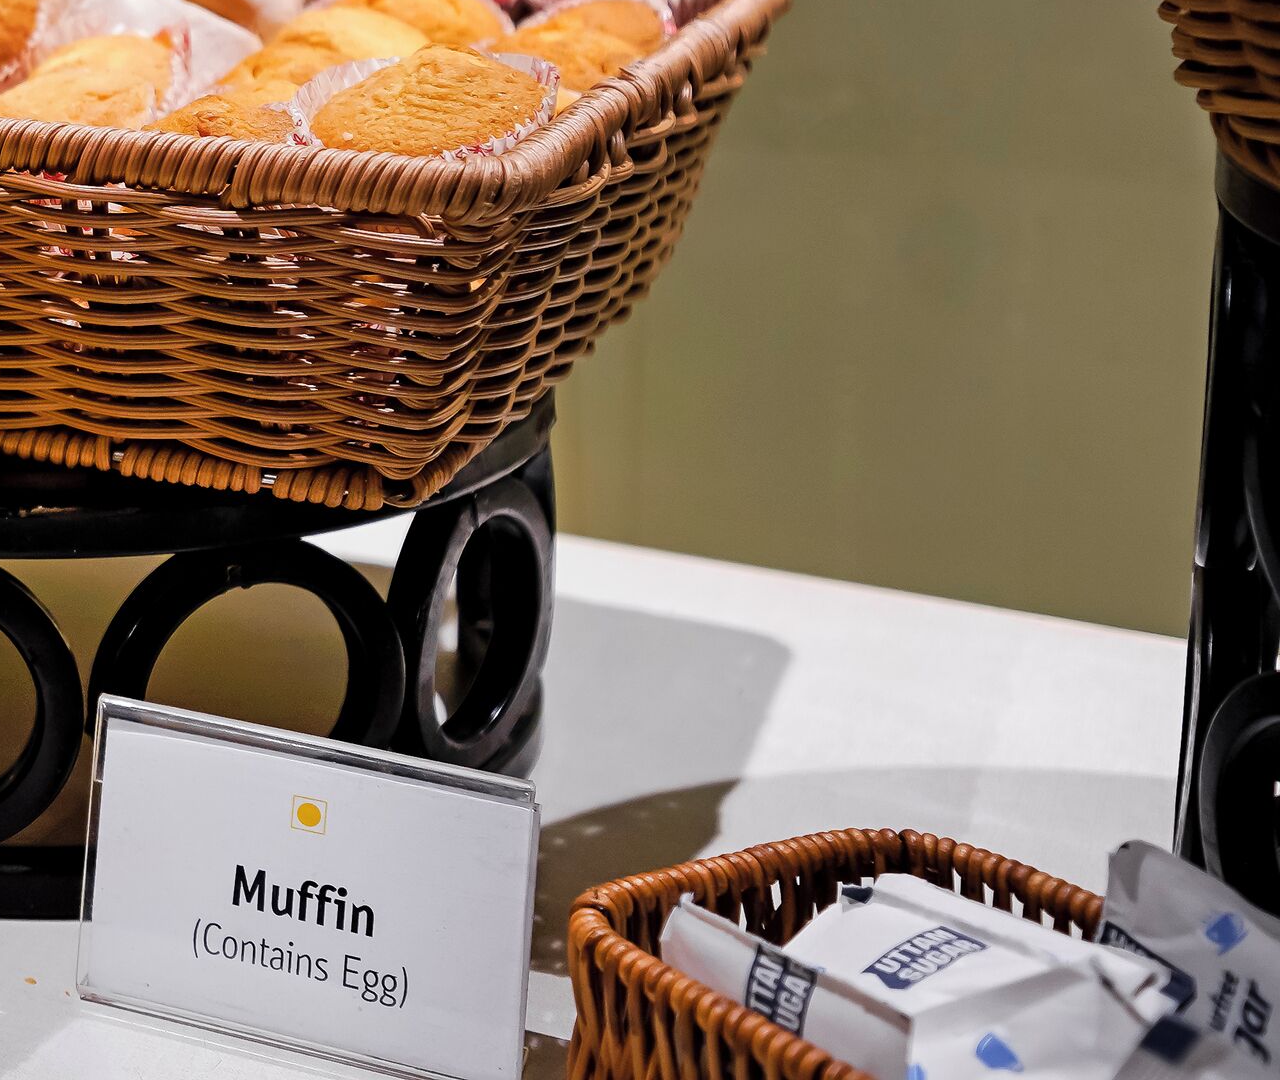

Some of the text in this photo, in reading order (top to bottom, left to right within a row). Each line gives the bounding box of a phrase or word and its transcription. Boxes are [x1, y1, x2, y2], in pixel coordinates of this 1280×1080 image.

[232, 864, 375, 938] Muffin
[193, 918, 408, 1008] (Contains Egg)
[873, 928, 960, 974] UTTAM
[896, 939, 983, 981] SUGAR
